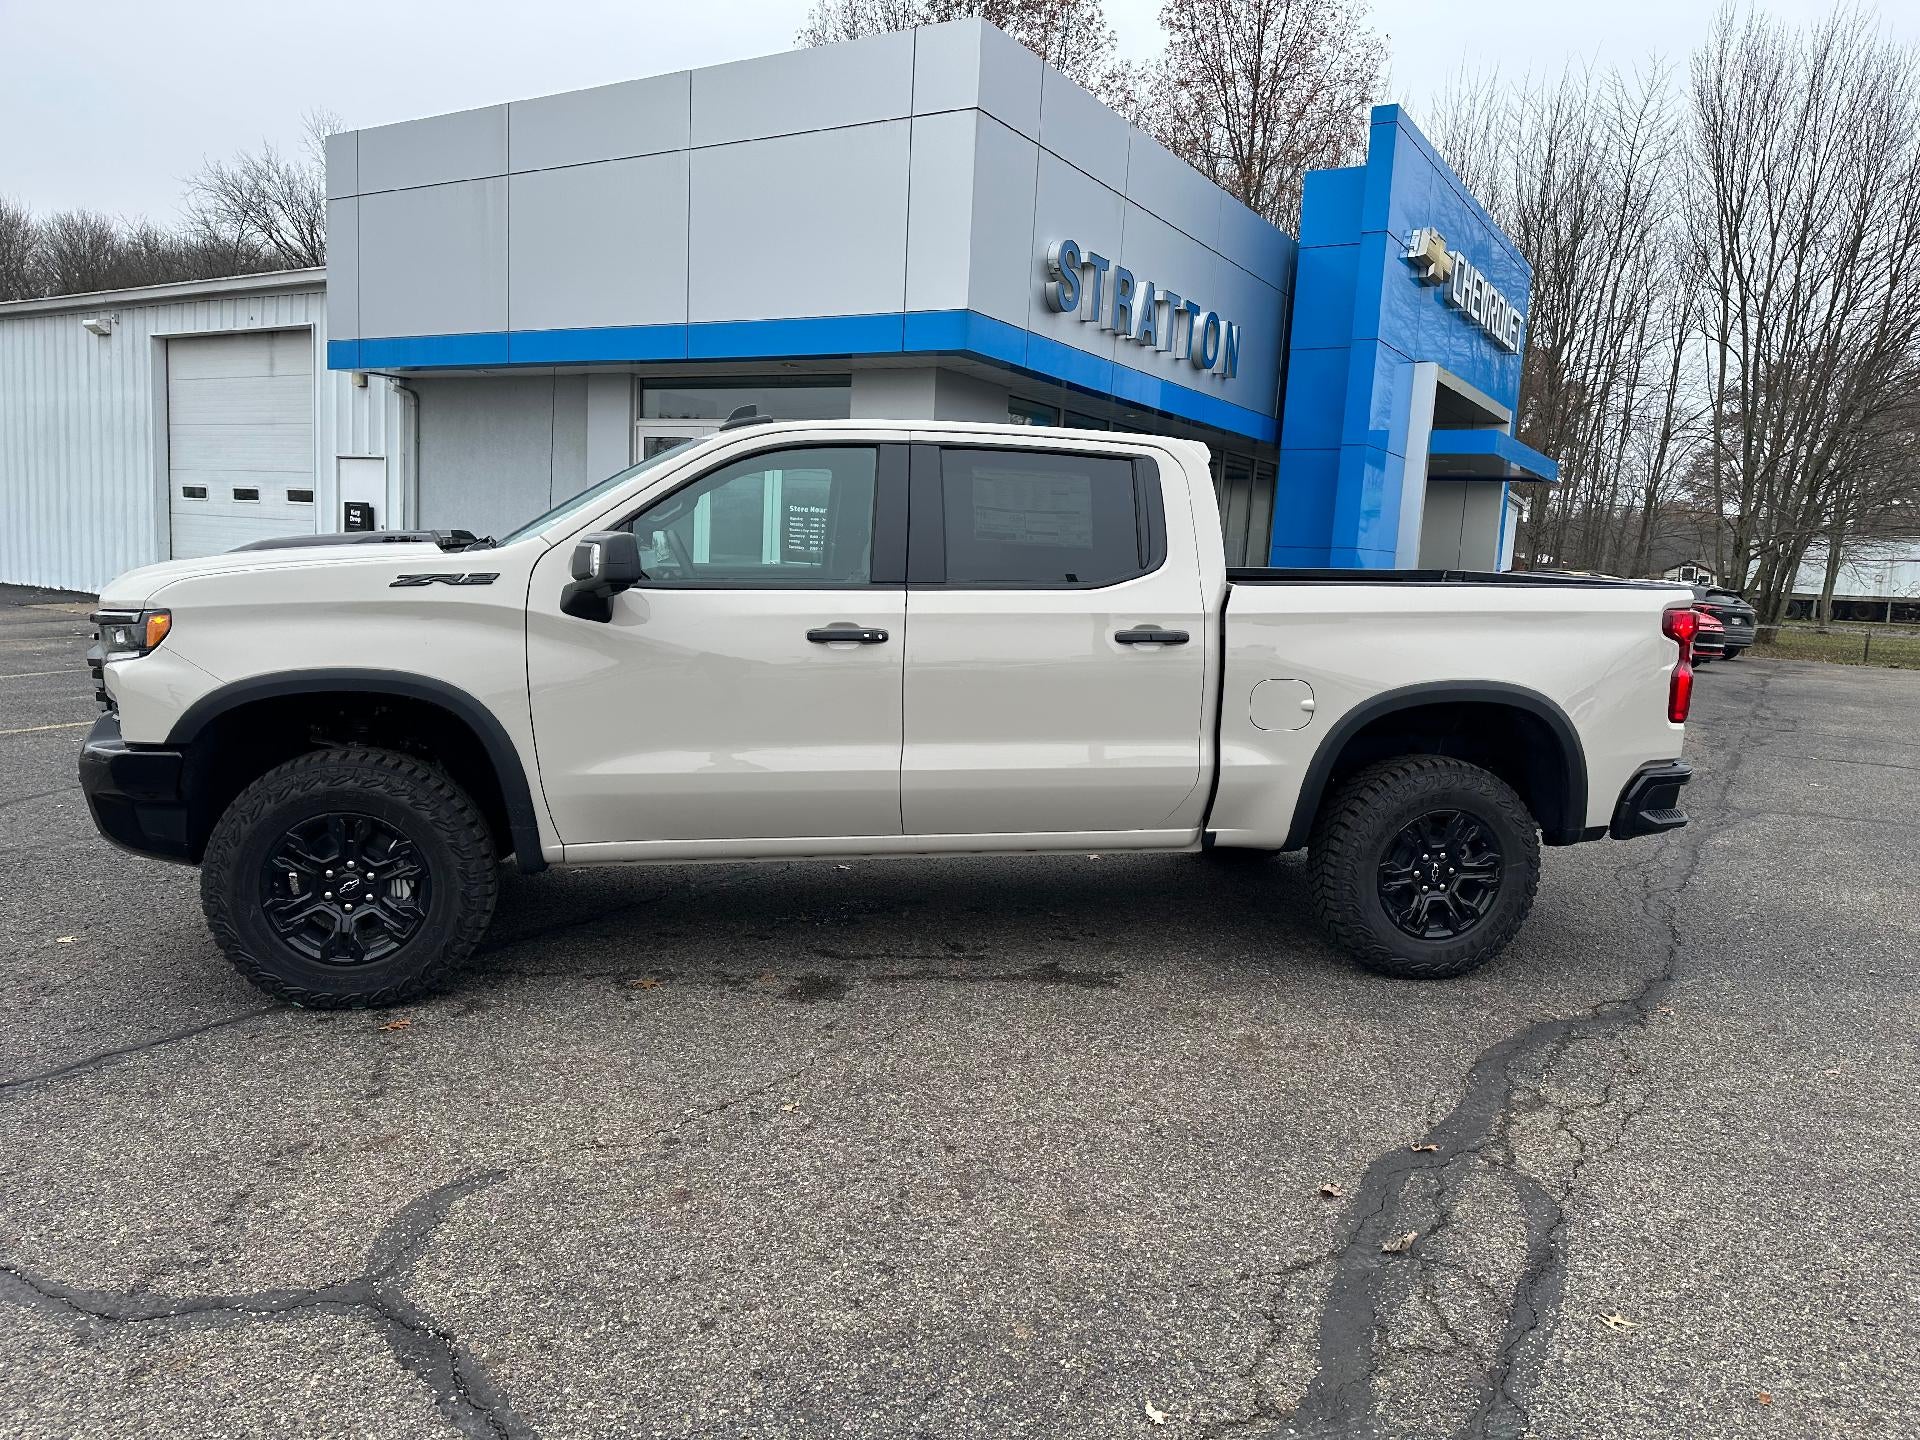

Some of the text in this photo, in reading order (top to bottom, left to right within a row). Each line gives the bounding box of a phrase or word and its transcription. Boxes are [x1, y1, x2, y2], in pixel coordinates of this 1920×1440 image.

[1045, 239, 1241, 379] STRATTON
[1452, 251, 1524, 355] CHEVROLET
[349, 515, 362, 524] Drop
[350, 509, 361, 517] Key
[389, 572, 500, 587] ZR2
